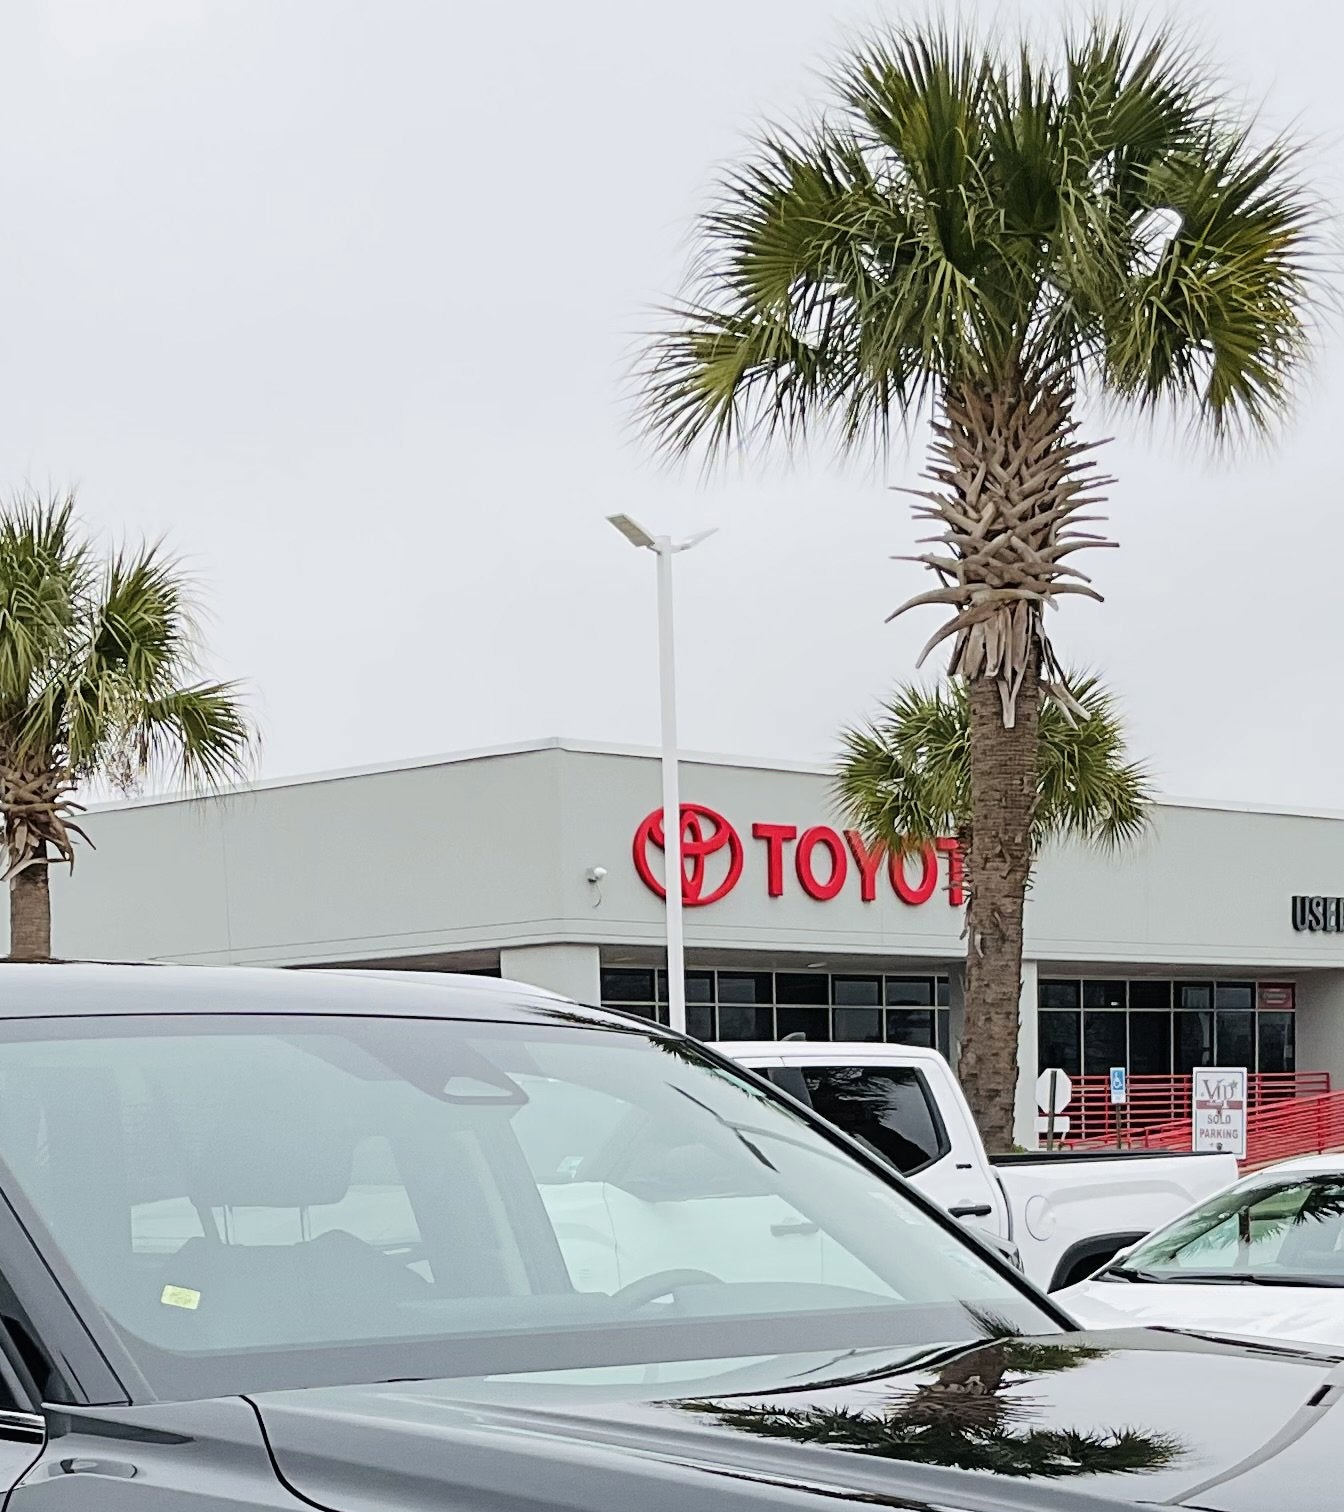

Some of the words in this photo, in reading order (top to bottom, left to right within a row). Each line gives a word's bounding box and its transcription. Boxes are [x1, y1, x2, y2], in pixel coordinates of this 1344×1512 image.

[752, 823, 968, 907] TOYOT
[1207, 1114, 1232, 1125] SOLD
[1199, 1127, 1239, 1140] PARKING
